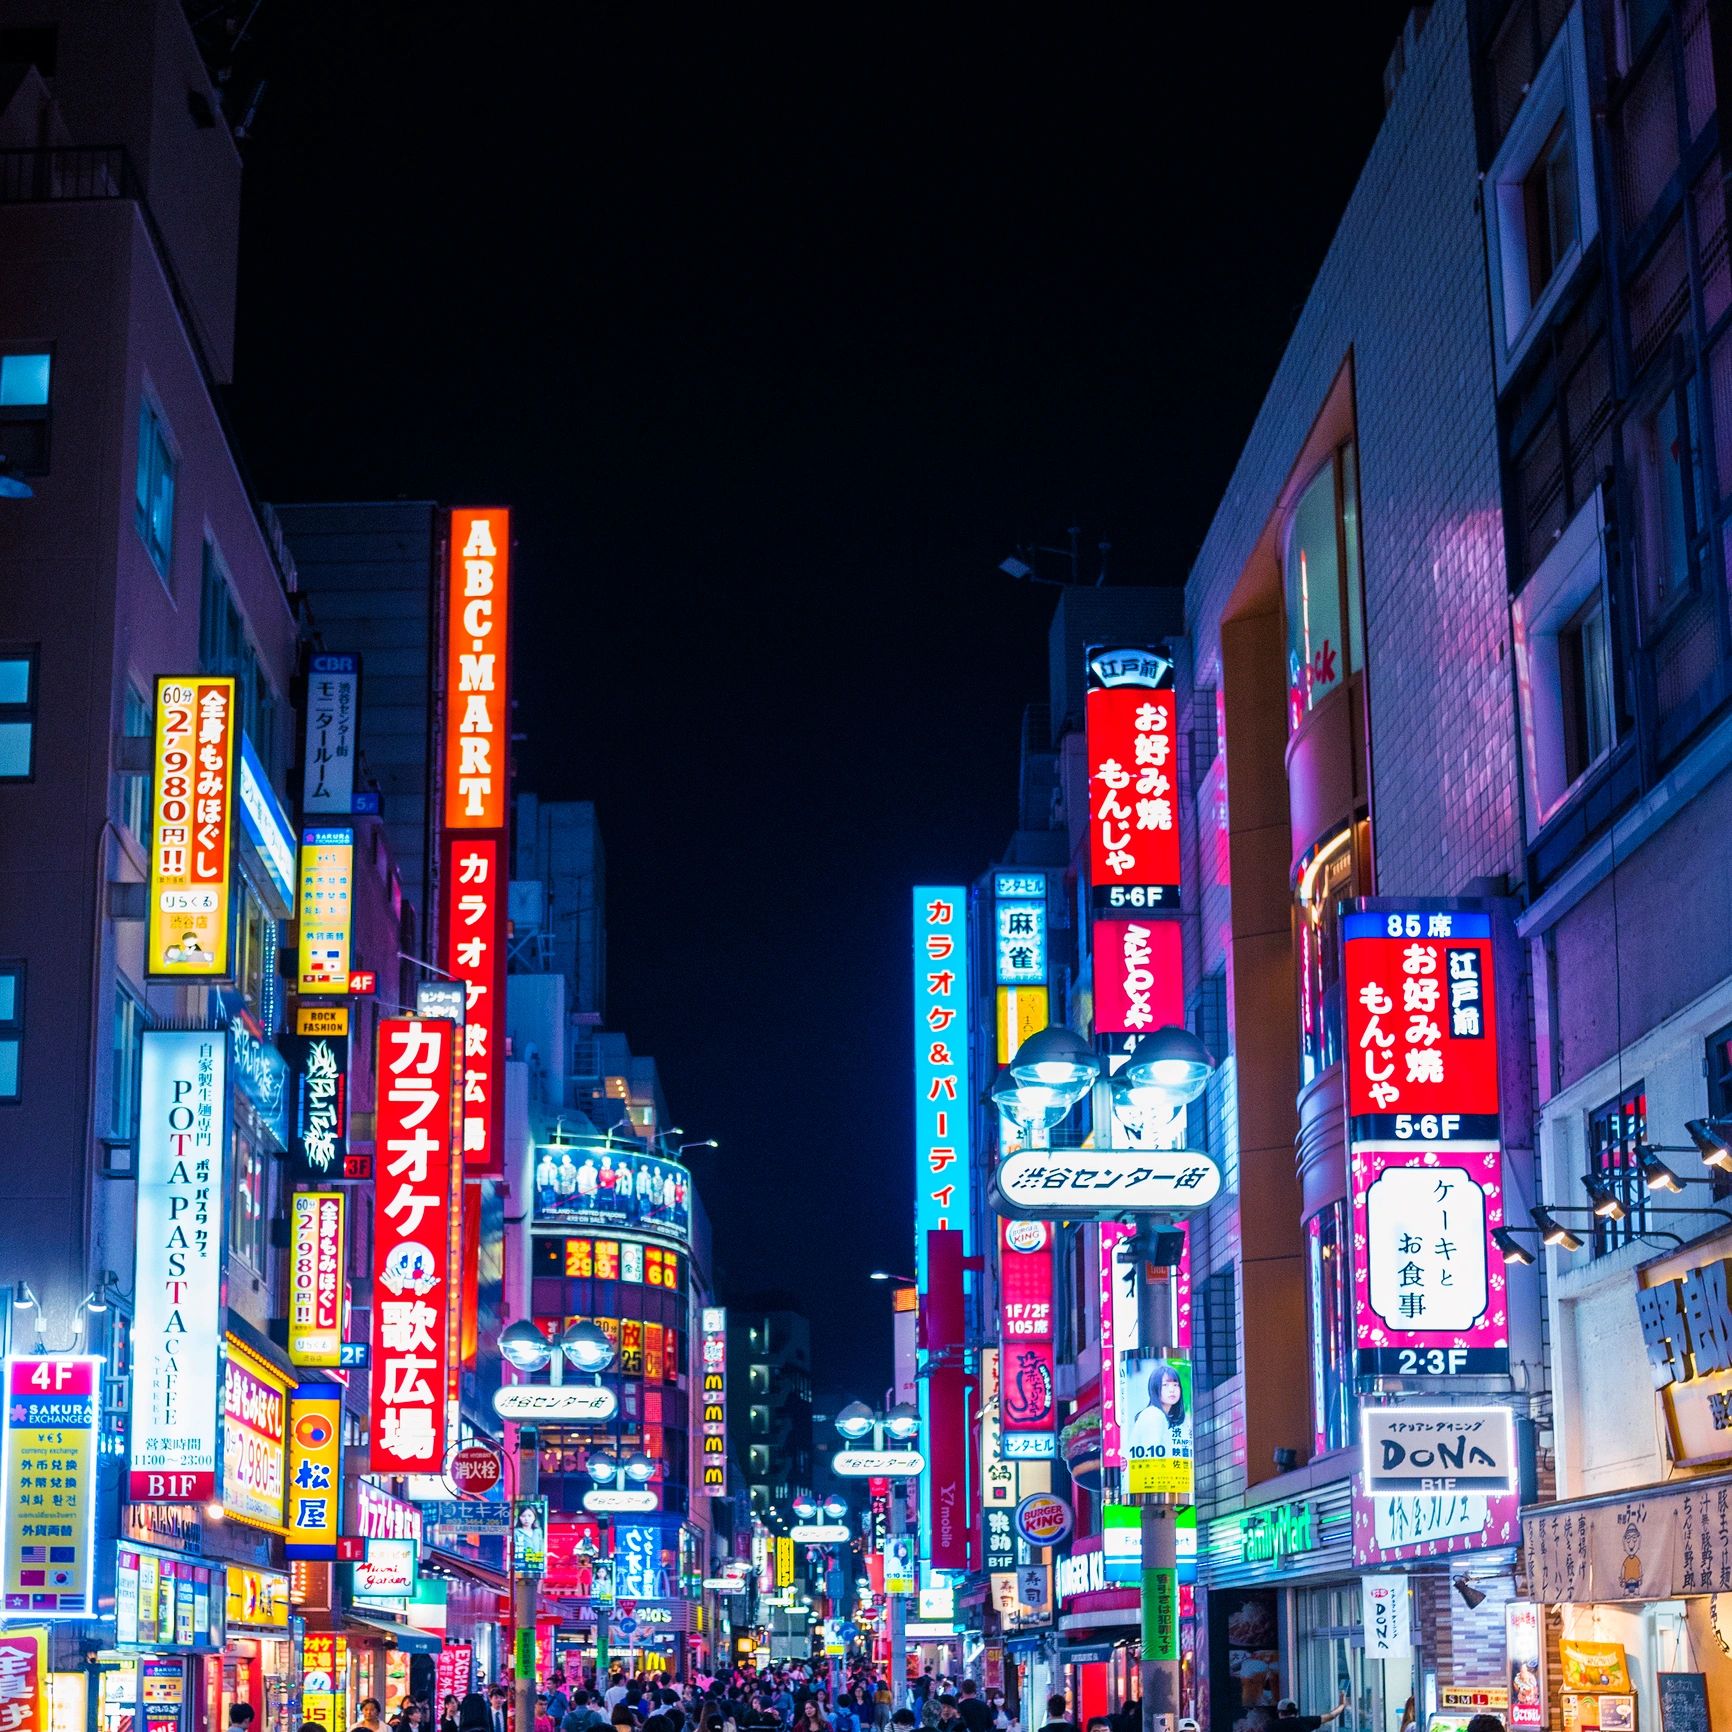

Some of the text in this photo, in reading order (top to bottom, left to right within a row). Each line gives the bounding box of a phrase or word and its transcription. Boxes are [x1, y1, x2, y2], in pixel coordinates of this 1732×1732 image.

[314, 657, 351, 671] CBR
[1102, 660, 1159, 679] 江戸前
[163, 687, 193, 704] 60分
[312, 682, 334, 798] モニタールーム
[1135, 702, 1173, 831] お好み焼
[196, 690, 227, 878] 全身もみほぐし
[1098, 758, 1136, 876] もんじゃ
[997, 880, 1044, 893] センタービル
[165, 896, 212, 907] りらくる
[170, 916, 208, 929] 渋谷店
[1009, 913, 1034, 970] 麻雀
[349, 977, 373, 990] 4F
[1450, 952, 1479, 1036] 江戸前
[1402, 943, 1444, 1083] お好み焼
[303, 1023, 342, 1031] FASHION
[1359, 982, 1399, 1109] もんじゃ
[349, 1163, 370, 1175] 3F
[1012, 1167, 1210, 1188] 渋谷センター街
[379, 1022, 441, 1460] カラオケ歌広場
[1014, 1233, 1040, 1244] KING
[1433, 1180, 1457, 1287] ケーキと
[318, 1201, 338, 1326] 全身もみほぐし
[1398, 1232, 1426, 1319] お食事
[1006, 1303, 1050, 1318] 1F/2F
[1007, 1320, 1049, 1334] 105席
[341, 1347, 365, 1363] 2F
[31, 1361, 74, 1390] 4F
[29, 1404, 93, 1415] SAKURA
[29, 1415, 83, 1424] EXCHANGE
[145, 1438, 201, 1450] 営業時間
[1004, 1438, 1054, 1452] センタービル
[1129, 1445, 1166, 1459] 10.10
[1380, 1434, 1496, 1470] DONA
[455, 1461, 497, 1480] 消火栓
[148, 1474, 197, 1497] B1F
[295, 1460, 331, 1528] 松屋
[1023, 1506, 1063, 1521] BURGER
[22, 1525, 72, 1537] 外貨両替
[1025, 1514, 1064, 1532] KING
[1240, 1503, 1312, 1570] FamilyMart
[343, 1541, 361, 1558] 1F
[988, 1557, 1013, 1567] B1F
[1000, 1580, 1014, 1608] 寿司
[1025, 1571, 1041, 1602] 寿司
